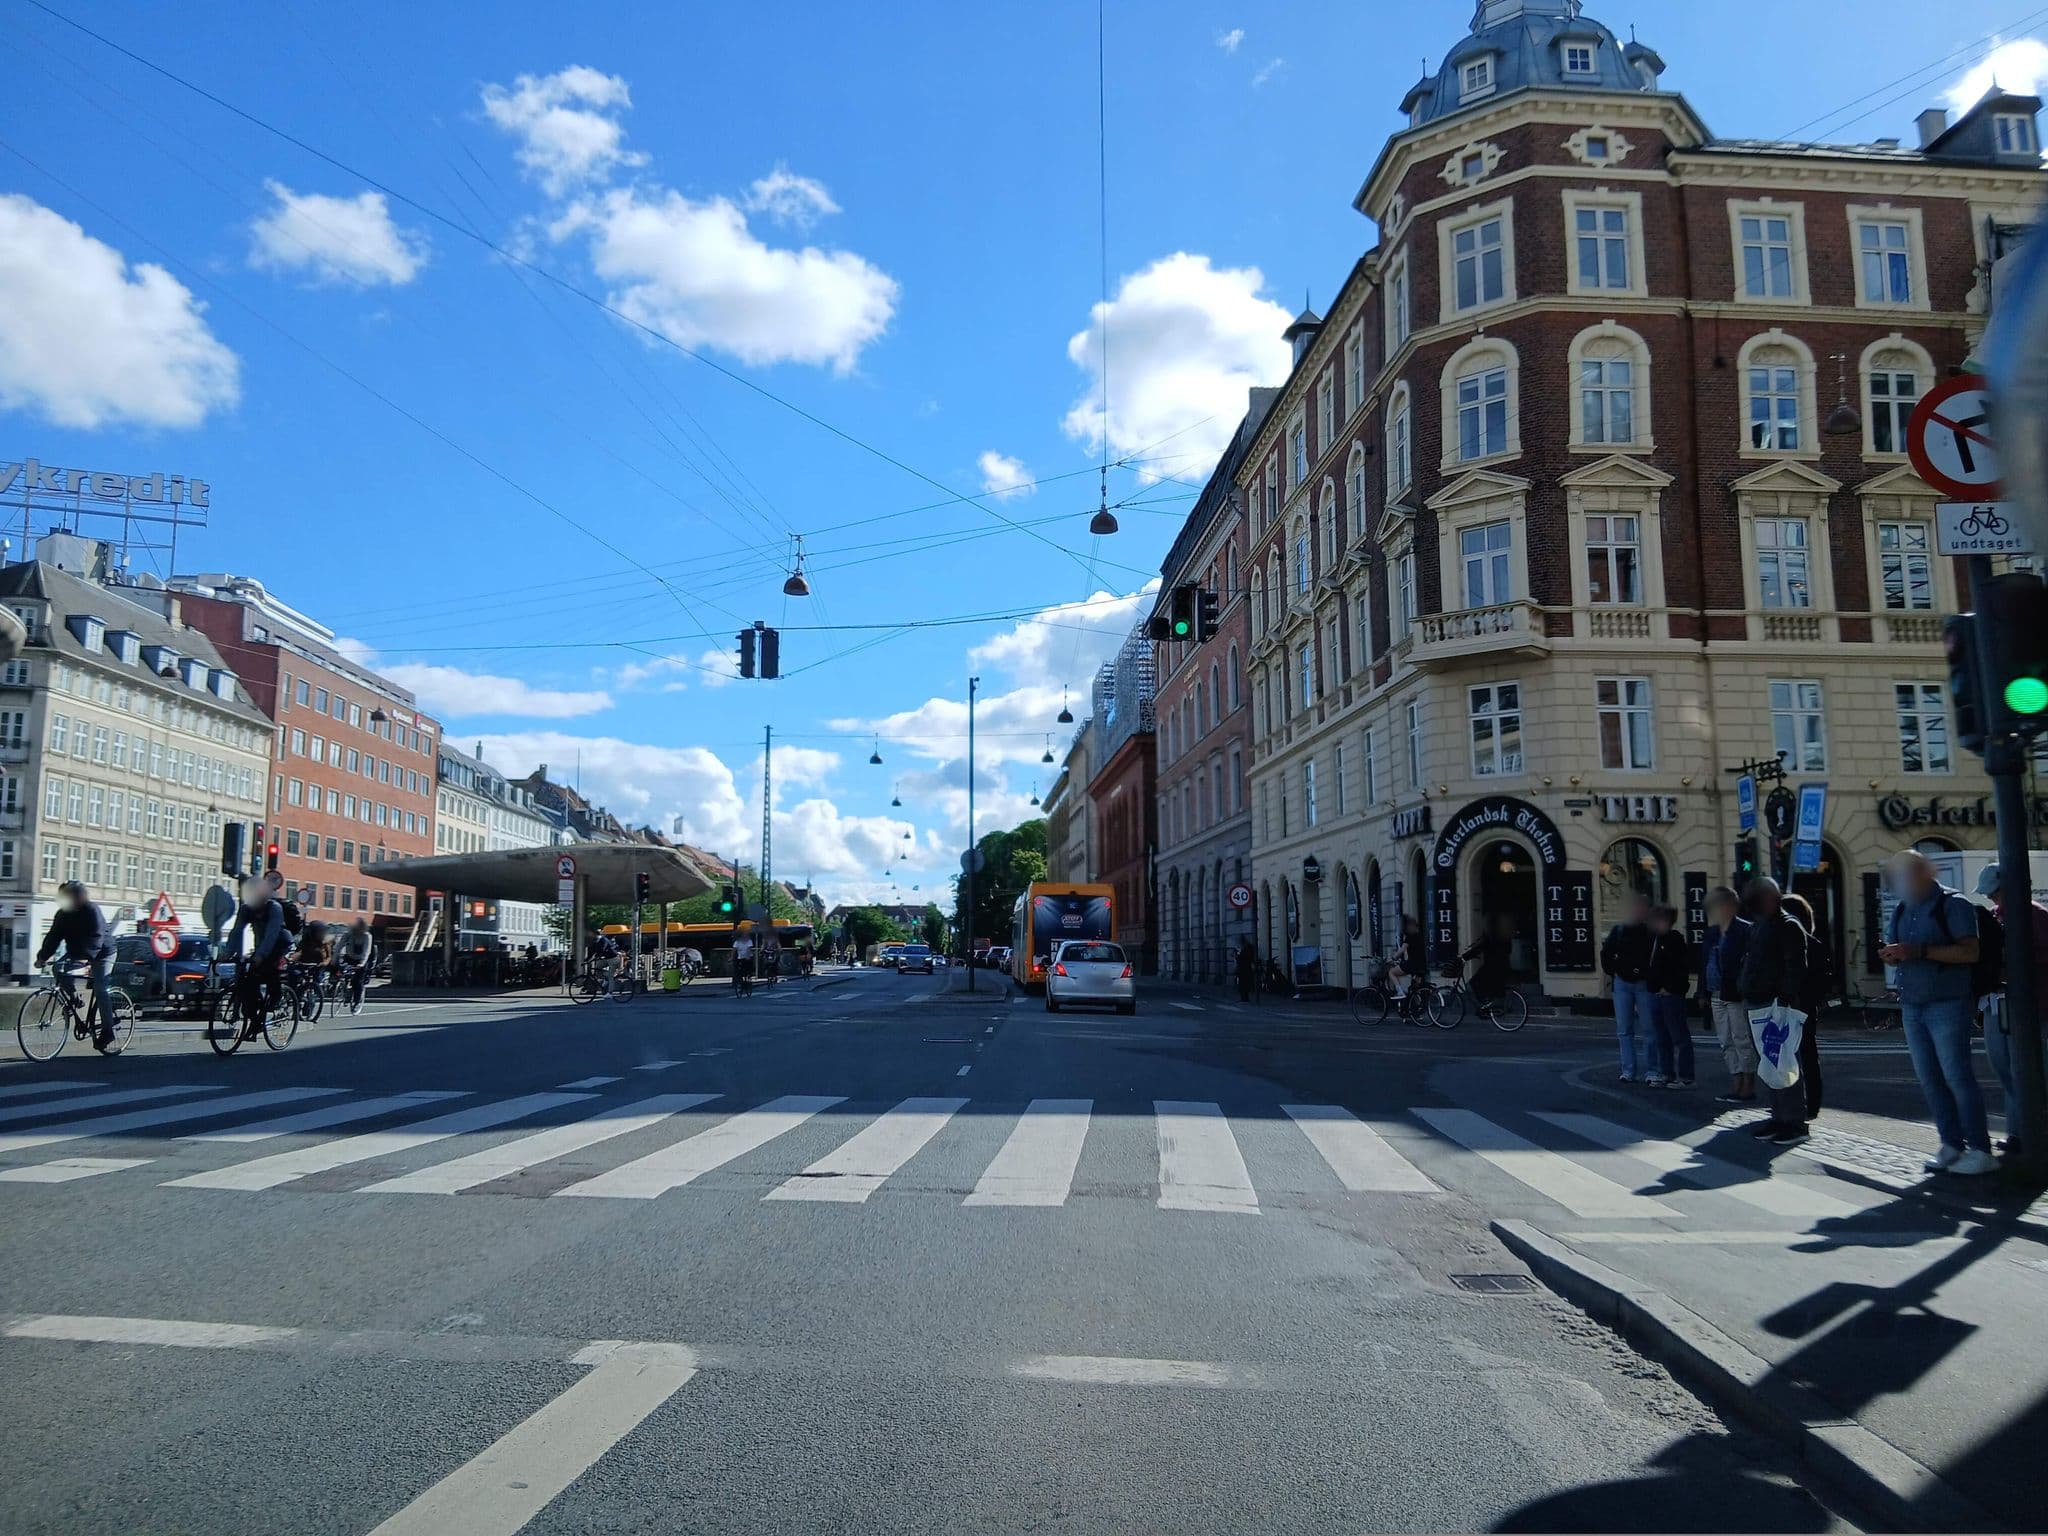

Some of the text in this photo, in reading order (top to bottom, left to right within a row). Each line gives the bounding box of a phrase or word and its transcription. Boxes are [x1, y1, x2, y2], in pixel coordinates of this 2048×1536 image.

[1951, 537, 2023, 550] undtaget
[1598, 794, 1678, 823] THE
[1232, 890, 1248, 902] 40
[1437, 888, 1452, 943] THE
[1548, 885, 1563, 943] THE
[1572, 885, 1588, 943] THE
[1689, 887, 1704, 944] THE
